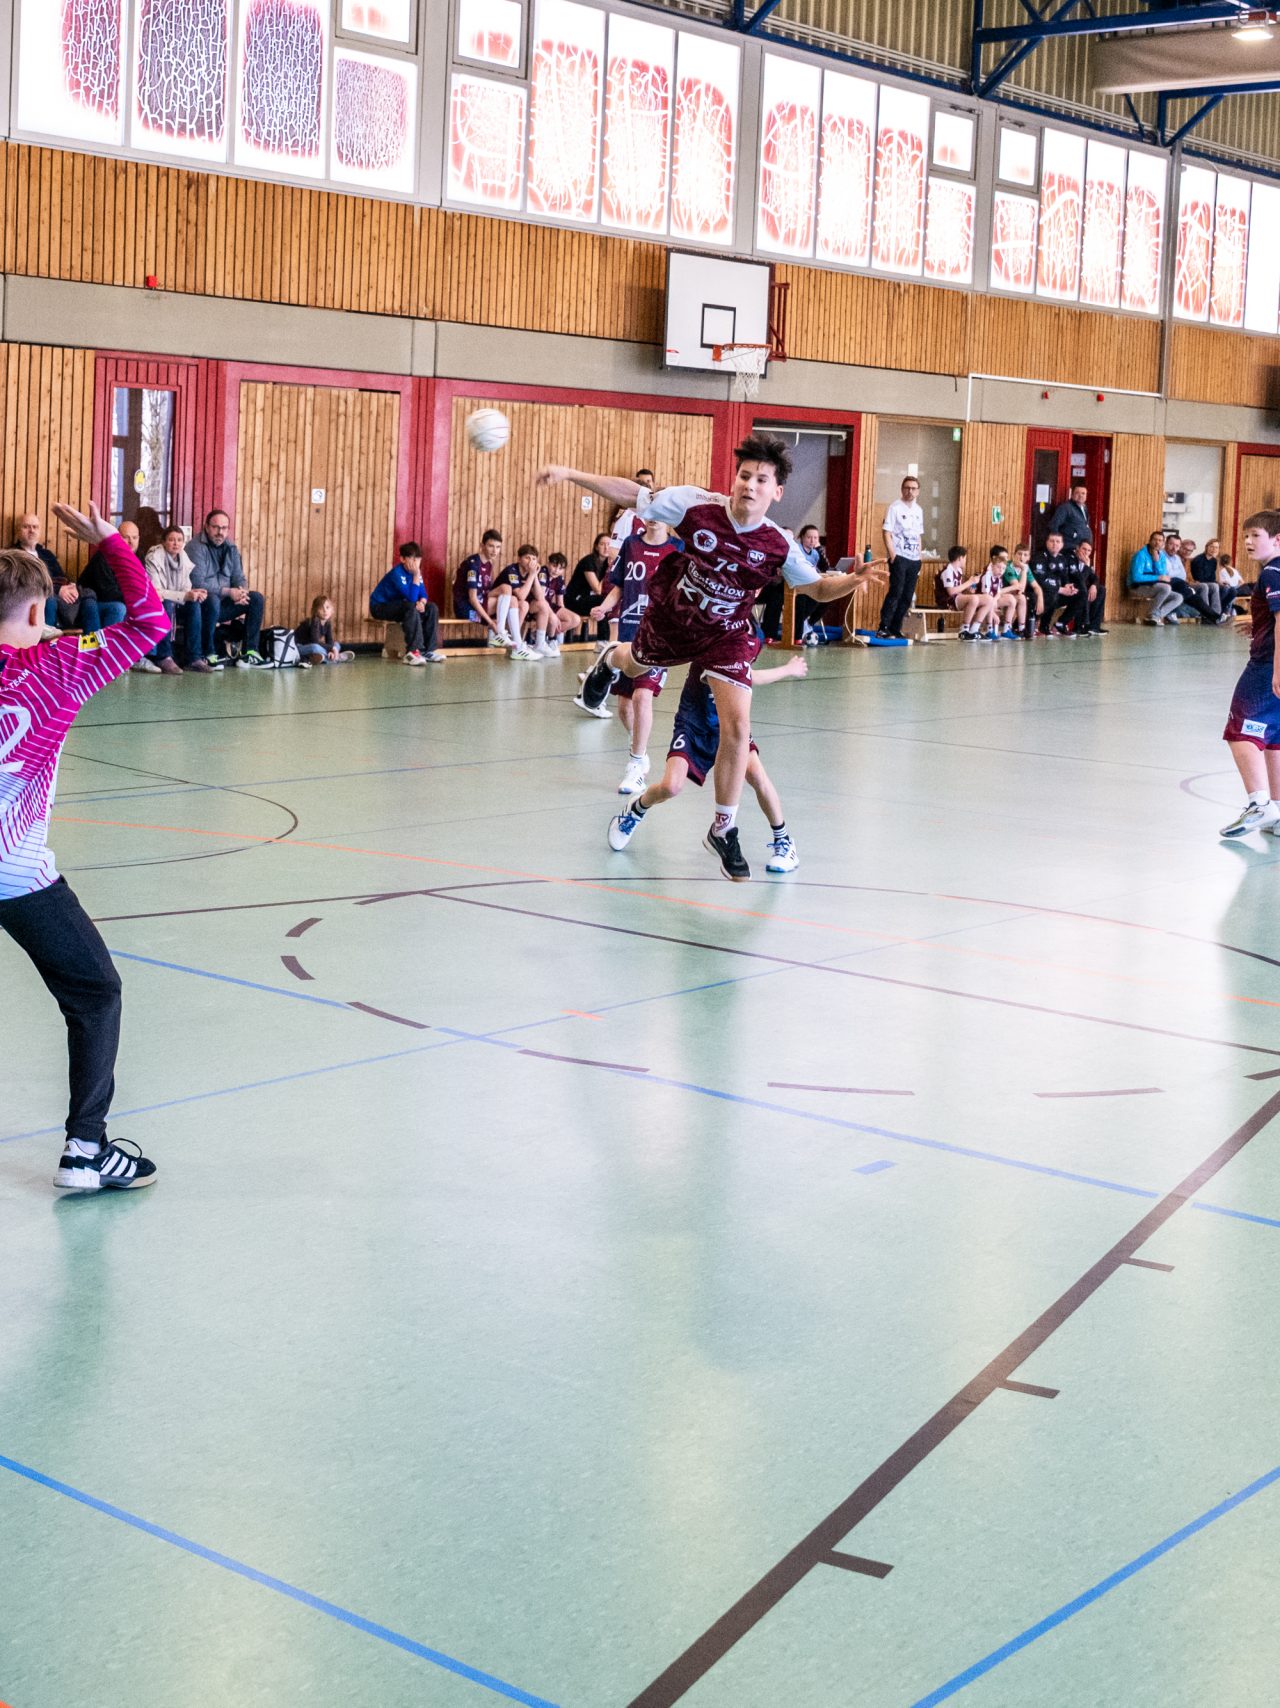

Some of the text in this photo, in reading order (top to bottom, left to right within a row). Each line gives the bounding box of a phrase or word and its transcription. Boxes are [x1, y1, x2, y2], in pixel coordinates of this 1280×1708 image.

[624, 561, 647, 581] 20
[713, 557, 739, 572] 74
[8, 668, 31, 689] TEAM
[672, 734, 686, 749] 6
